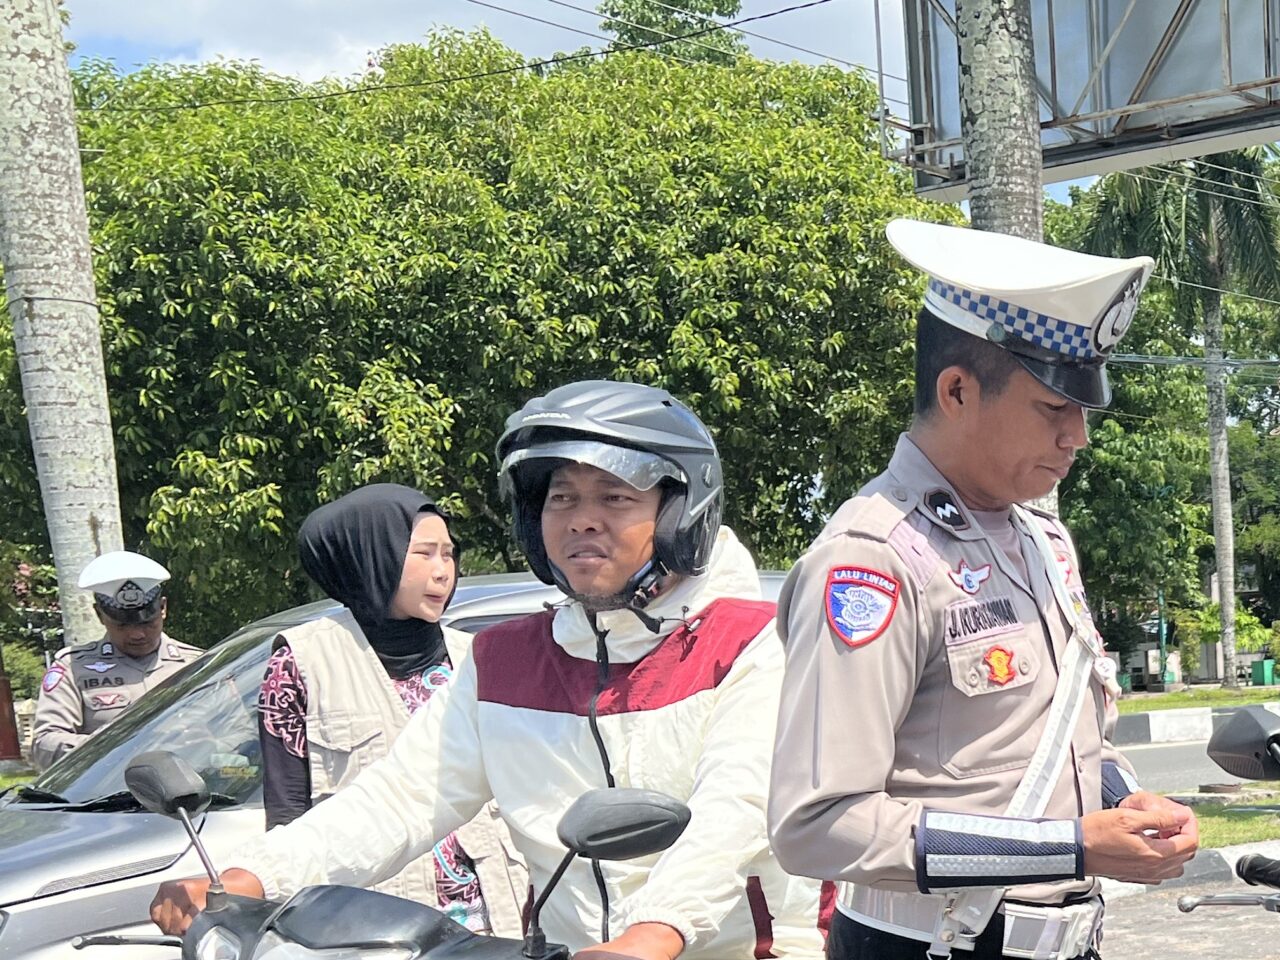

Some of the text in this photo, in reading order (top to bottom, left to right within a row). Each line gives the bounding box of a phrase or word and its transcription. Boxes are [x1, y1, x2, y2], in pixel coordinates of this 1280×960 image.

[834, 570, 896, 592] LALU LINTAS
[83, 676, 125, 689] IBAS
